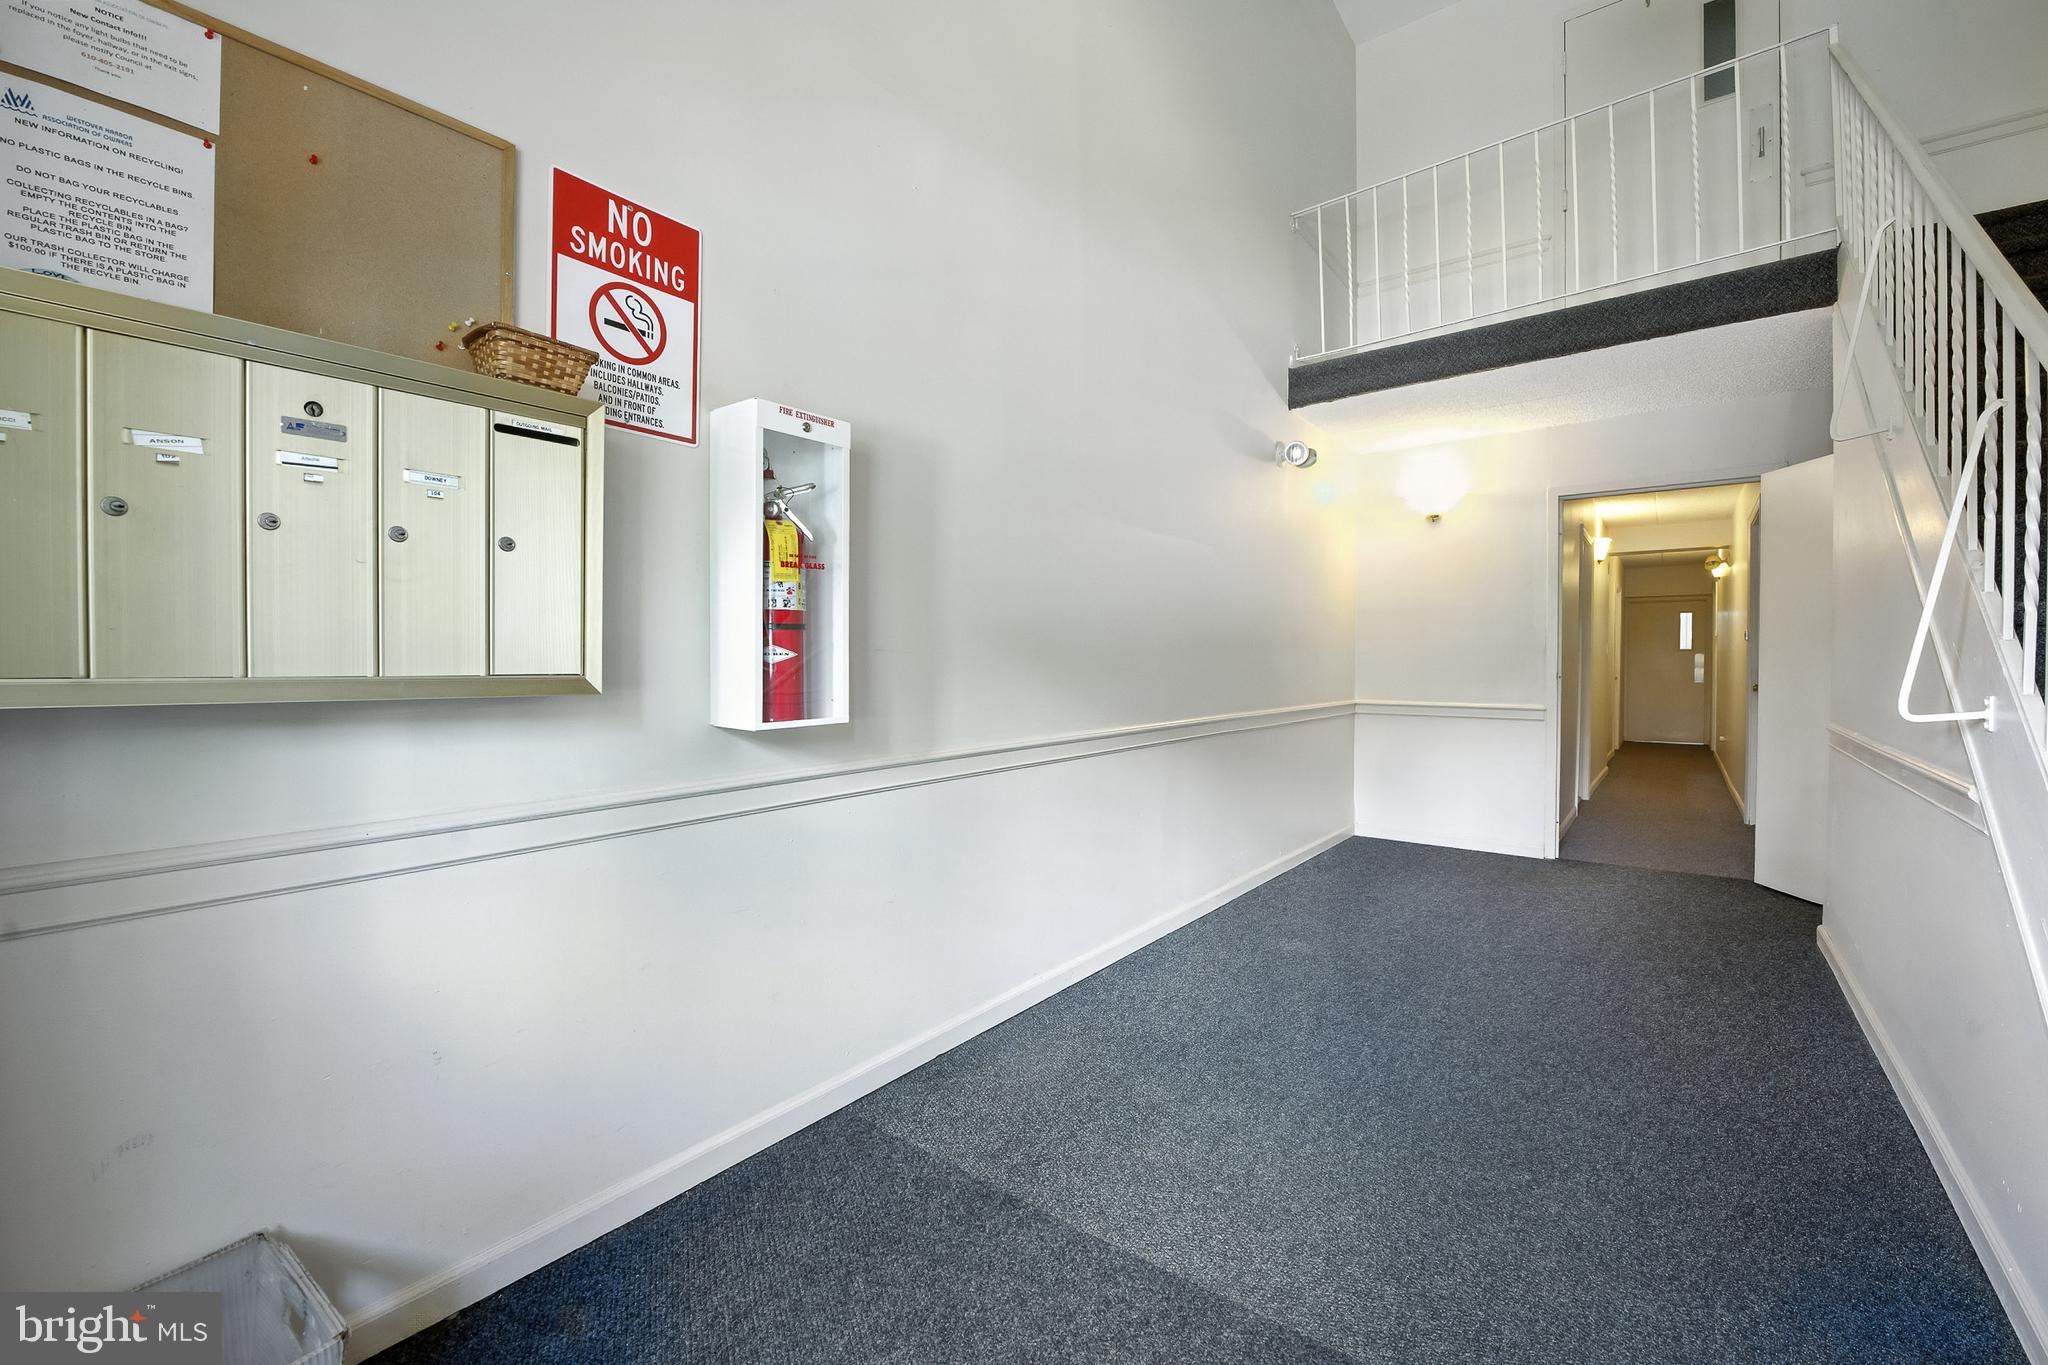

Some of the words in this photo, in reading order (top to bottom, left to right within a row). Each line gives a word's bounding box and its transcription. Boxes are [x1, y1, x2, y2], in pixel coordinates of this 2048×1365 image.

[70, 8, 88, 19] New
[90, 16, 121, 31] Contact
[123, 28, 147, 41] Info!!!
[94, 6, 124, 21] NOTICE
[9, 5, 45, 22] replaced
[57, 22, 70, 31] the
[150, 57, 163, 66] the
[164, 62, 177, 72] exit
[29, 4, 45, 13] you
[48, 11, 73, 23] notice
[75, 22, 89, 31] any
[91, 27, 108, 38] light
[110, 34, 131, 46] bulbs
[133, 42, 148, 52] that
[150, 49, 168, 60] need
[169, 56, 178, 64] to
[179, 60, 188, 68] be
[63, 34, 89, 48] please
[91, 45, 113, 57] notify
[115, 53, 142, 67] Council
[42, 114, 90, 134] ASSOCIATION
[103, 134, 133, 148] OWNERS
[66, 114, 104, 131] WESTOVER
[105, 127, 133, 141] HARBOR
[14, 117, 39, 129] NEW
[41, 125, 110, 152] INFORMATION
[112, 147, 126, 157] ON
[129, 152, 184, 175] RECYCLING!
[0, 136, 16, 146] NO
[18, 142, 61, 159] PLASTIC
[63, 154, 92, 168] BAGS
[93, 163, 104, 172] IN
[106, 167, 125, 178] THE
[127, 173, 170, 192] RECYCLE
[16, 164, 32, 174] DO
[35, 170, 56, 180] NOT
[59, 177, 80, 188] BAG
[82, 183, 110, 197] YOUR
[6, 178, 72, 201] COLLECTING
[74, 196, 144, 220] RECYCLABLES
[146, 216, 155, 224] IN
[165, 221, 189, 233] BAG?
[20, 190, 55, 204] EMPTY
[59, 200, 78, 210] THE
[80, 206, 132, 225] CONTENTS
[135, 220, 157, 232] INTO
[159, 227, 177, 237] THE
[68, 210, 114, 228] RECYCLE
[7, 209, 57, 228] REGULAR
[59, 223, 93, 237] TRASH
[95, 233, 111, 242] BIN
[113, 237, 128, 245] OR
[130, 241, 168, 256] RETURN
[169, 252, 188, 261] THE
[22, 206, 56, 220] PLACE
[59, 215, 79, 225] THE
[81, 221, 121, 236] PLASTIC
[123, 232, 143, 242] BAG
[156, 240, 175, 250] THE
[30, 223, 73, 239] PLASTIC
[75, 235, 96, 245] BAG
[98, 240, 111, 249] TO
[113, 244, 132, 255] THE
[608, 198, 652, 247] NO
[4, 232, 28, 243] OUR
[30, 239, 65, 252] TRASH
[67, 248, 126, 267] COLLECTOR
[128, 262, 150, 274] WILL
[151, 268, 190, 283] CHARGE
[8, 241, 46, 256] $100.00
[60, 254, 93, 267] THERE
[115, 267, 154, 281] PLASTIC
[156, 277, 175, 287] BAG
[177, 281, 187, 289] IN
[60, 261, 80, 272] THE
[83, 266, 121, 281] RECYLE
[570, 225, 685, 292] SMOKING
[590, 368, 626, 386] INCLUDES
[594, 359, 616, 372] OKING
[618, 365, 626, 374] IN
[626, 367, 657, 383] COMMON
[658, 377, 680, 390] AREAS.
[598, 394, 612, 405] AND
[614, 398, 622, 407] IN
[623, 399, 645, 413] FRONT
[647, 407, 656, 415] OF
[605, 406, 622, 419] DING
[624, 411, 664, 429] ENTRANCES.
[779, 405, 793, 417] FIRE
[795, 410, 835, 428] EXTINGUISHER
[516, 421, 540, 430] OUTGOING
[424, 475, 447, 483] DOWNEY
[780, 560, 803, 569] BREAK
[804, 561, 825, 570] GLASS
